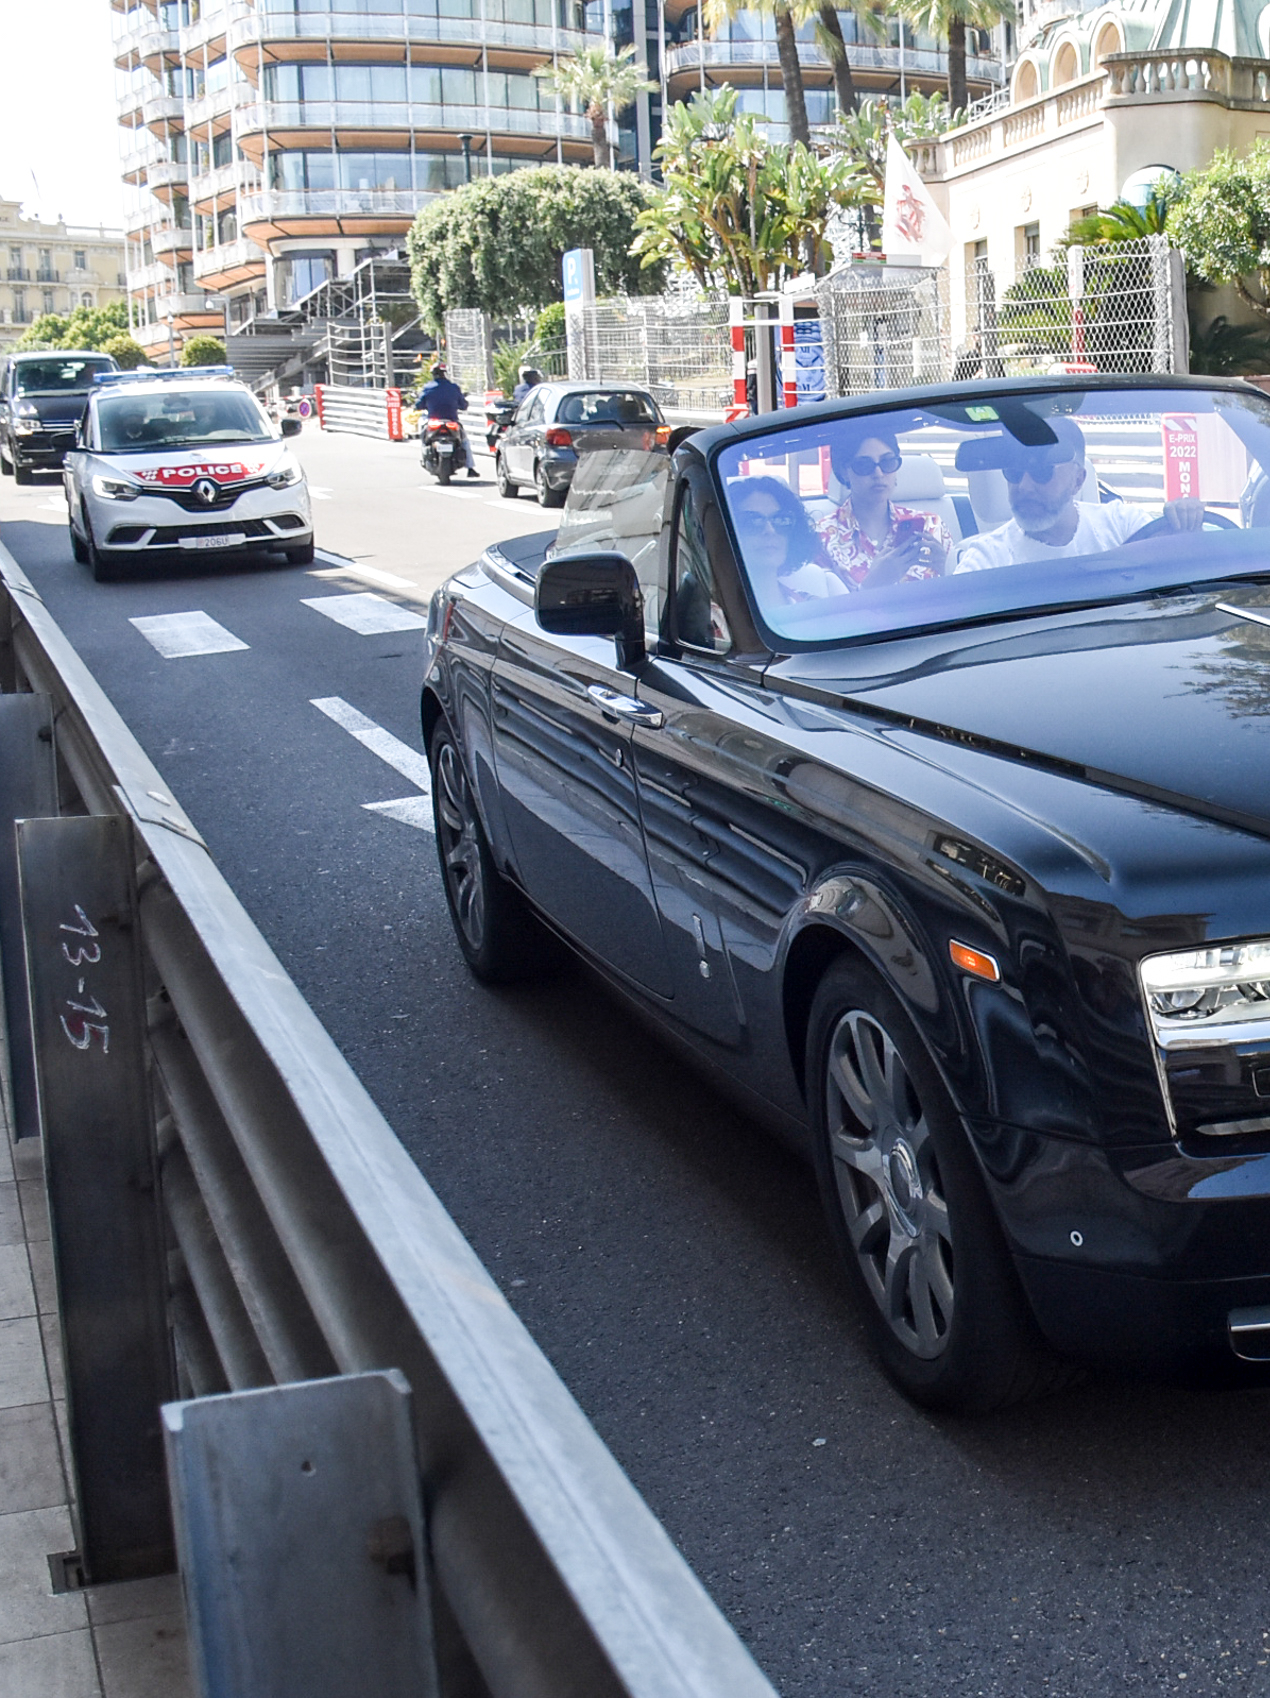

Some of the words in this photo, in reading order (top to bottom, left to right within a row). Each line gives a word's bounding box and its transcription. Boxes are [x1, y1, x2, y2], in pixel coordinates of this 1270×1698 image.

[1168, 433, 1196, 443] E-PRIX
[1169, 446, 1197, 457] 2022
[162, 464, 242, 478] POLICE
[204, 537, 228, 547] 206U
